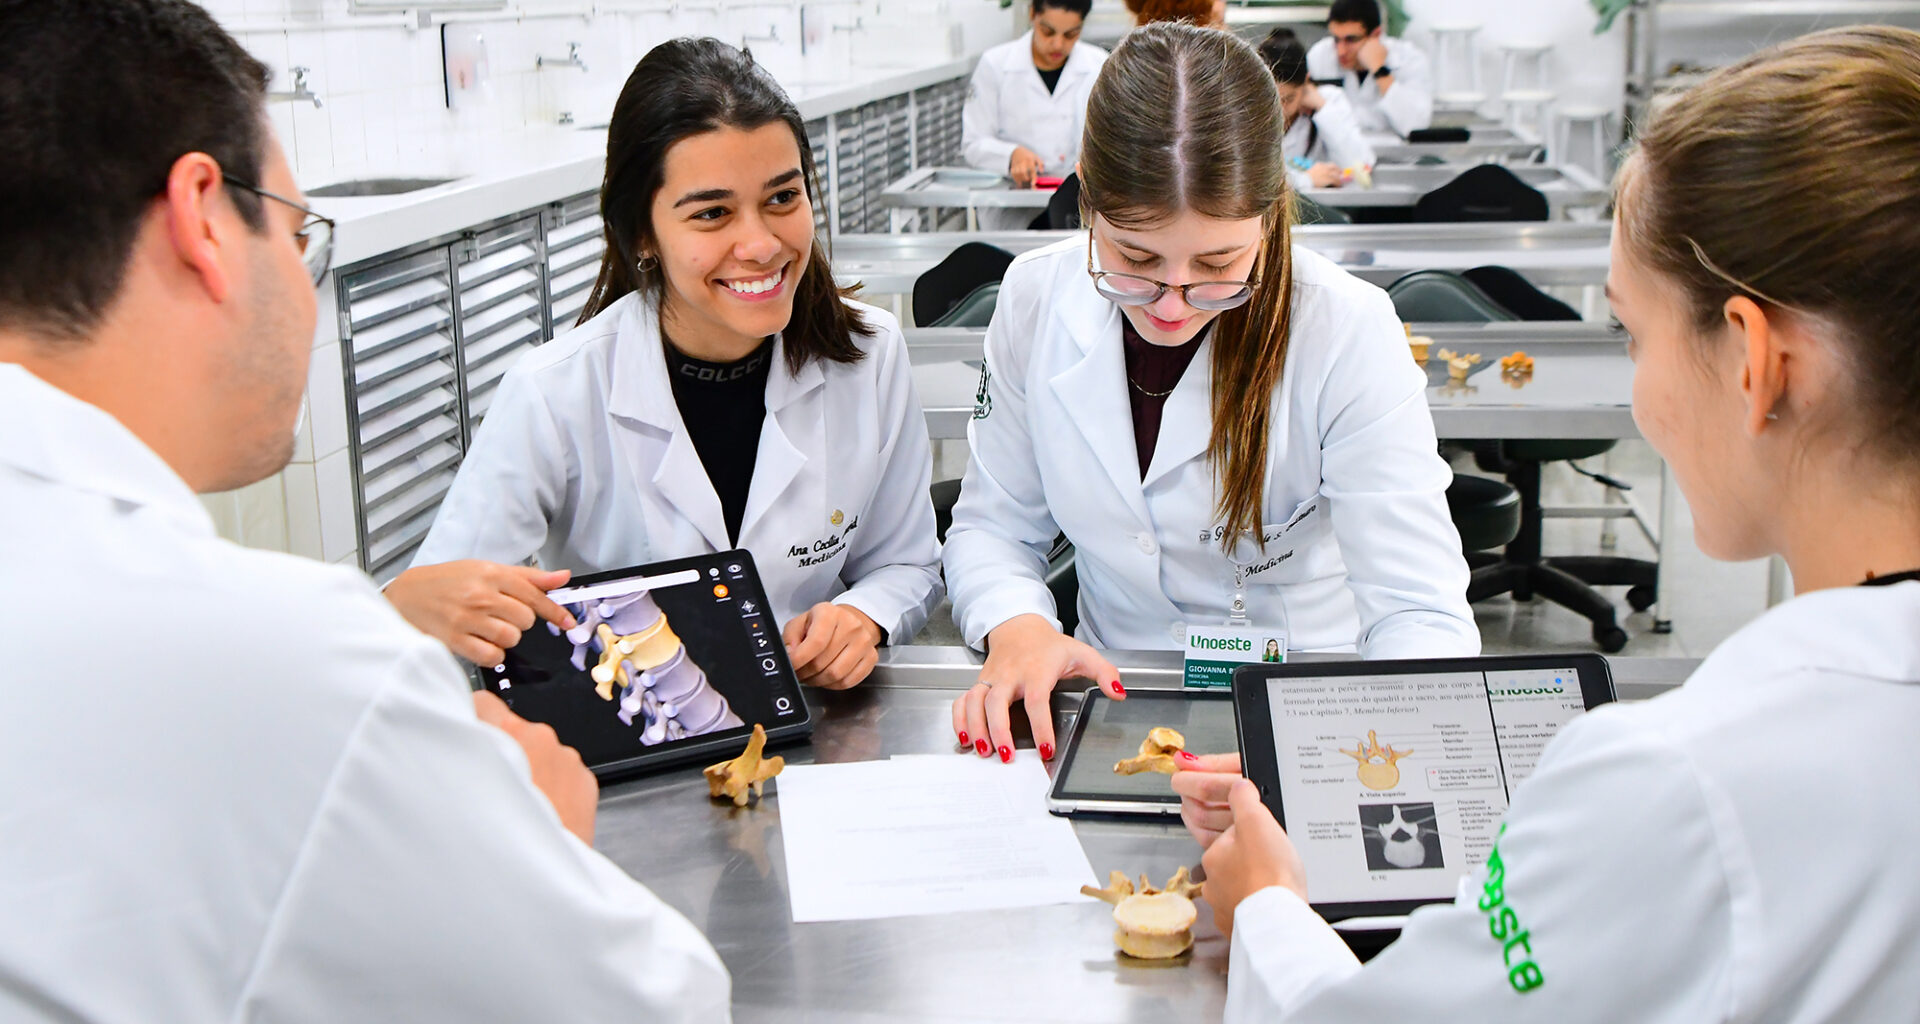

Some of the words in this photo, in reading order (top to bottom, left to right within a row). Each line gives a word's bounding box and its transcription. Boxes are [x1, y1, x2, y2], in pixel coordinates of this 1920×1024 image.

[787, 545, 809, 558] Ana
[798, 542, 846, 568] Medicina
[1245, 550, 1293, 577] Medicina
[1190, 635, 1252, 651] Unoeste
[1188, 665, 1227, 674] GIOVANNA
[1417, 681, 1435, 691] peso
[1451, 680, 1473, 690] corpo
[1283, 697, 1315, 706] formado
[1317, 696, 1337, 706] pelos
[1361, 695, 1371, 703] do
[1373, 693, 1399, 705] quadril
[1454, 692, 1474, 703] quais
